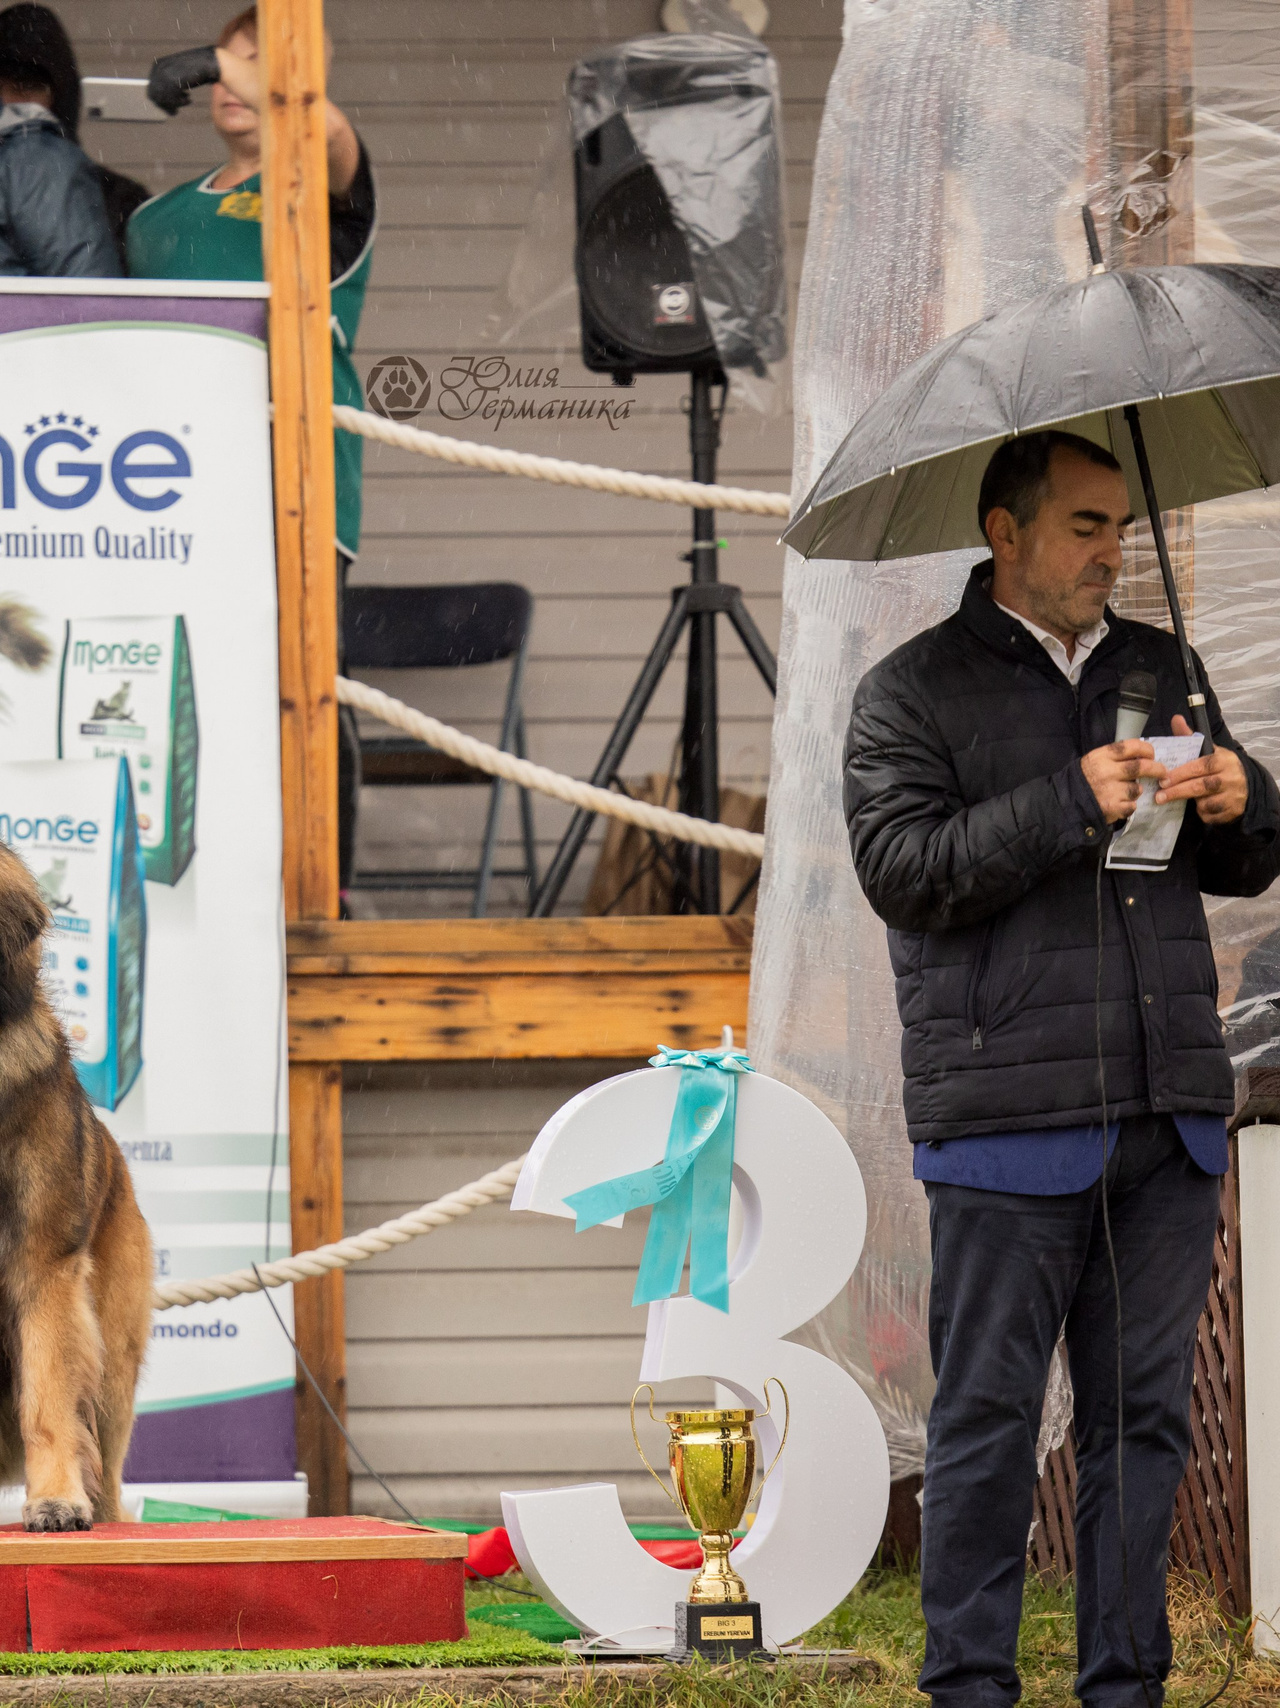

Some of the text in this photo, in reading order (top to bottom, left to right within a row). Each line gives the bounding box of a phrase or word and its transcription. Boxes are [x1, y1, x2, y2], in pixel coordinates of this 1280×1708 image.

[93, 525, 194, 565] Quality
[153, 1318, 238, 1339] mondo
[717, 1619, 736, 1627] BIG 3
